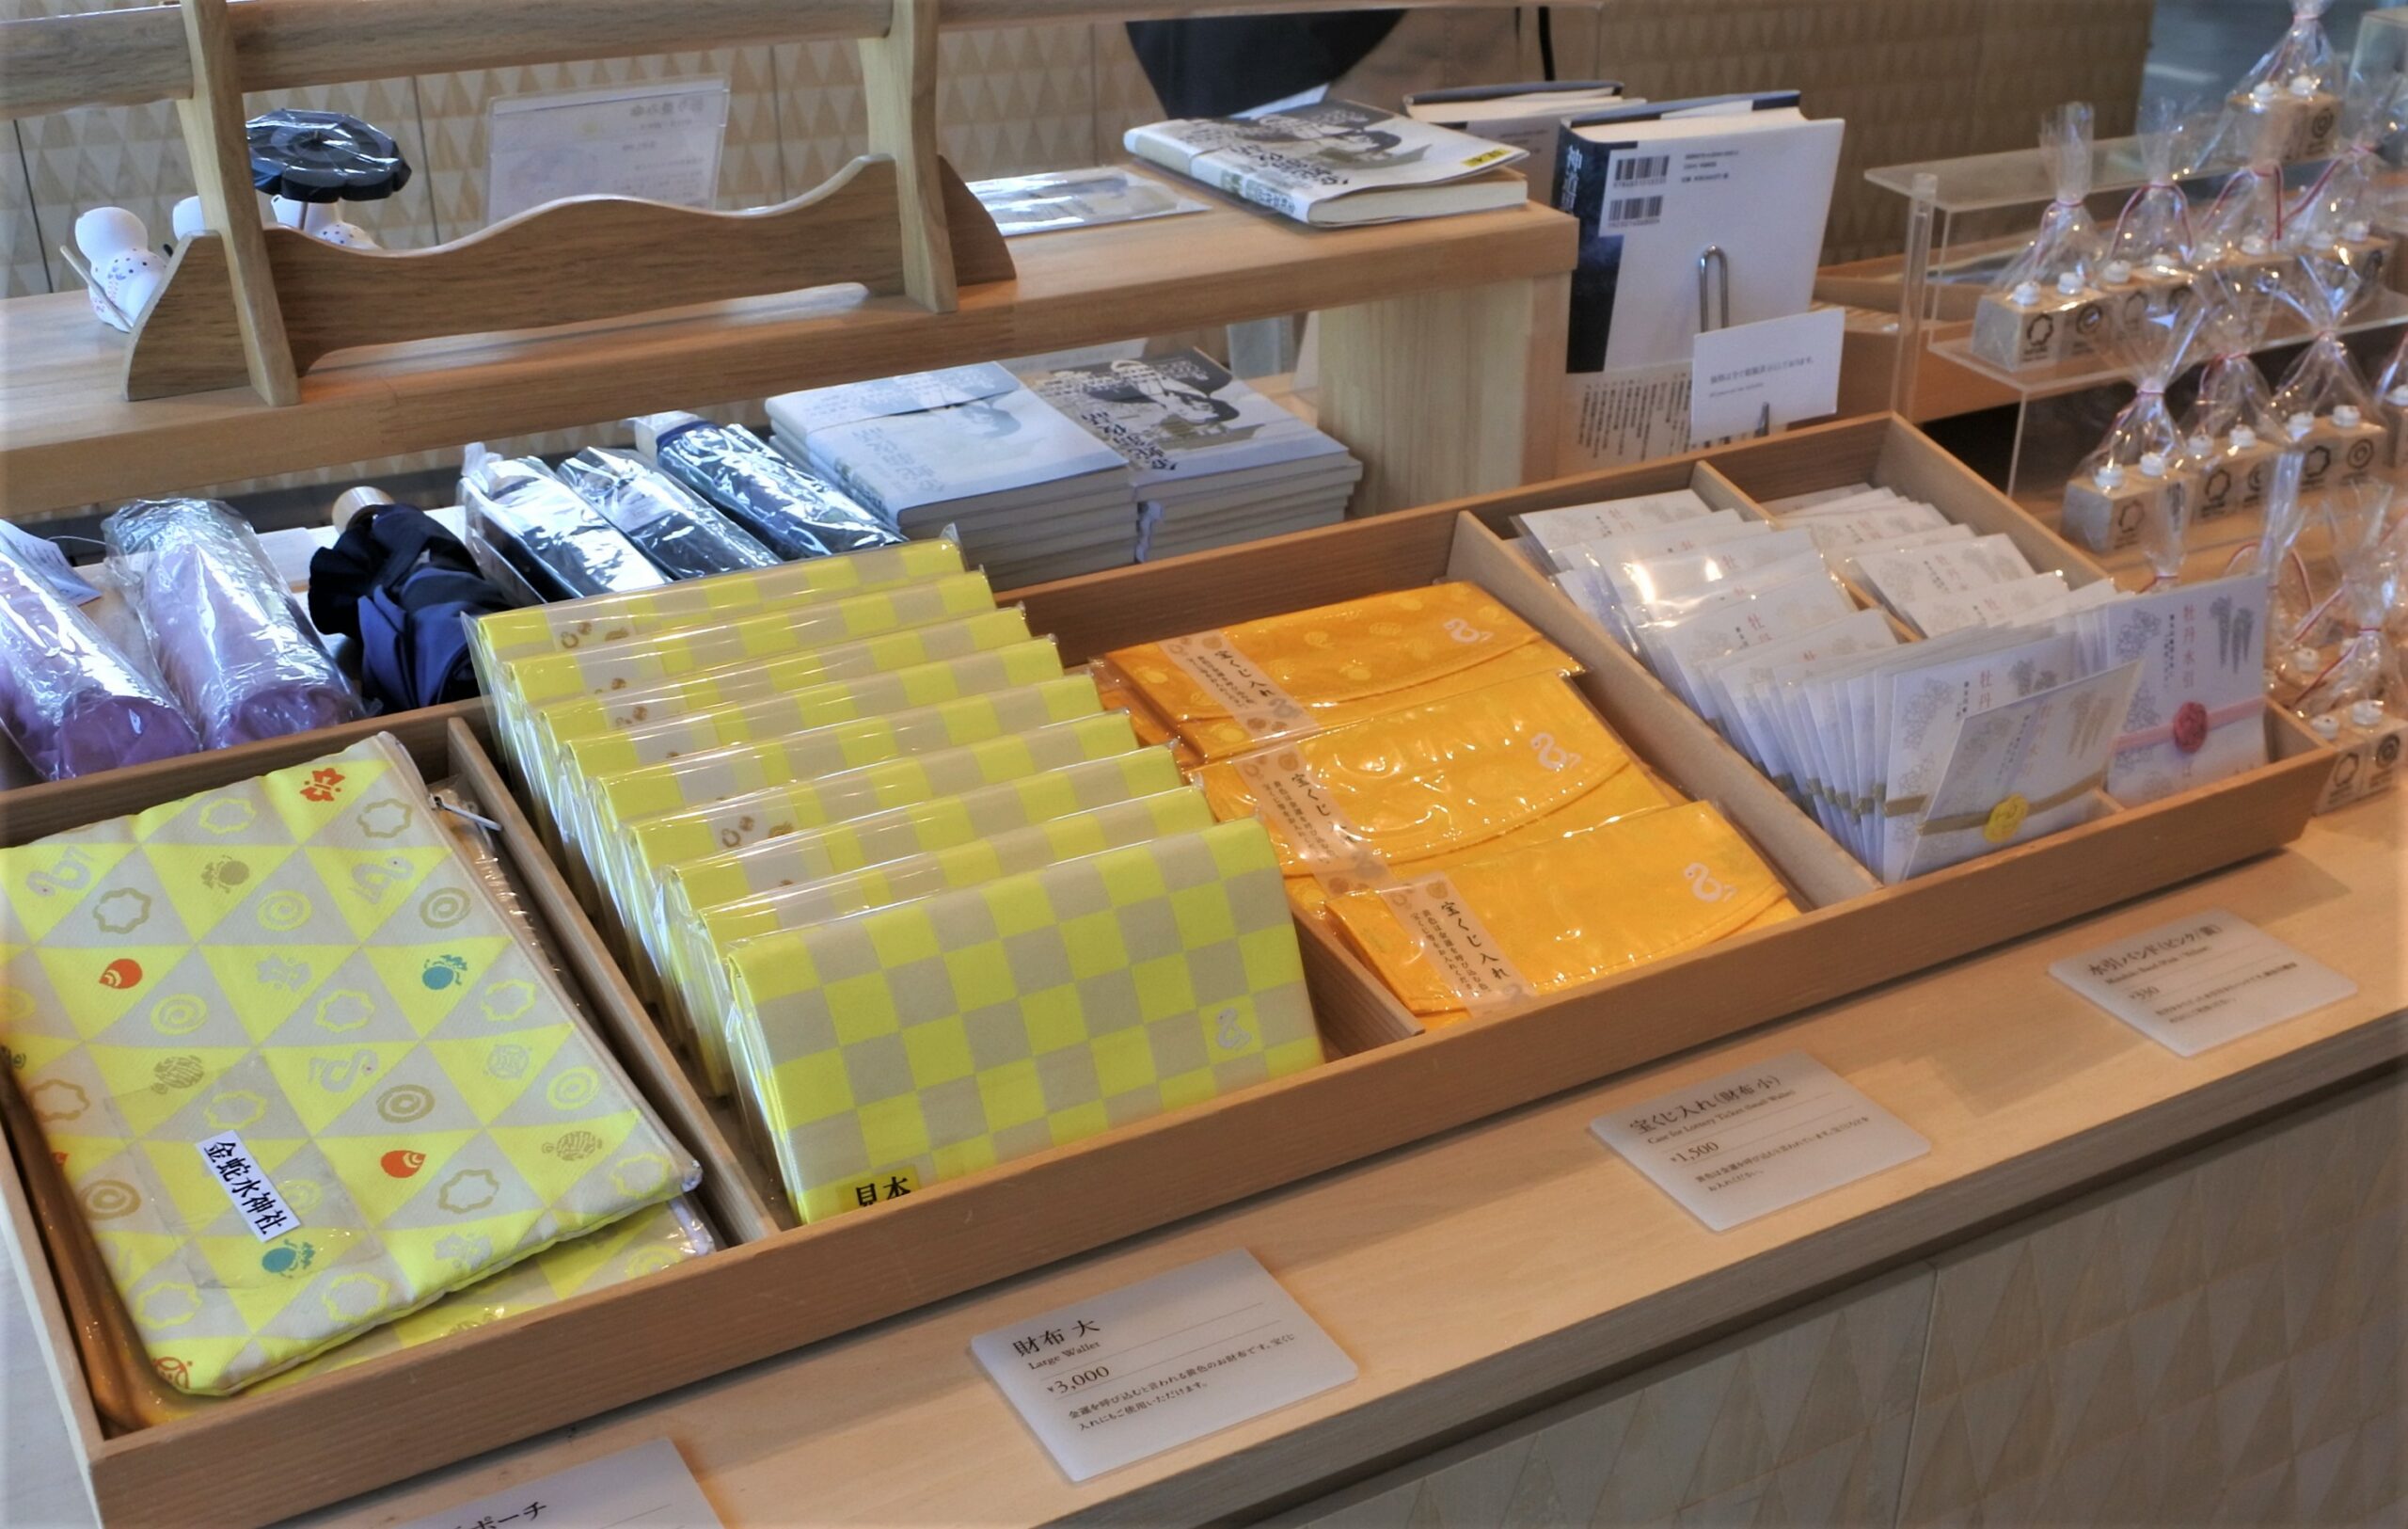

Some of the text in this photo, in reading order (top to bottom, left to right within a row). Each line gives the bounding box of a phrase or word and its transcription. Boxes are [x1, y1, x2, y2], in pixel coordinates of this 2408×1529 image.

[1440, 900, 1511, 980] 宝くじ入れ
[203, 1140, 287, 1235] 金蛇水神社
[855, 1175, 911, 1207] 見本
[1012, 1319, 1101, 1357] 財布 大
[1028, 1341, 1101, 1370] Large Wallet
[1046, 1365, 1110, 1394] ¥3,000
[455, 1501, 547, 1529] ポーチ
